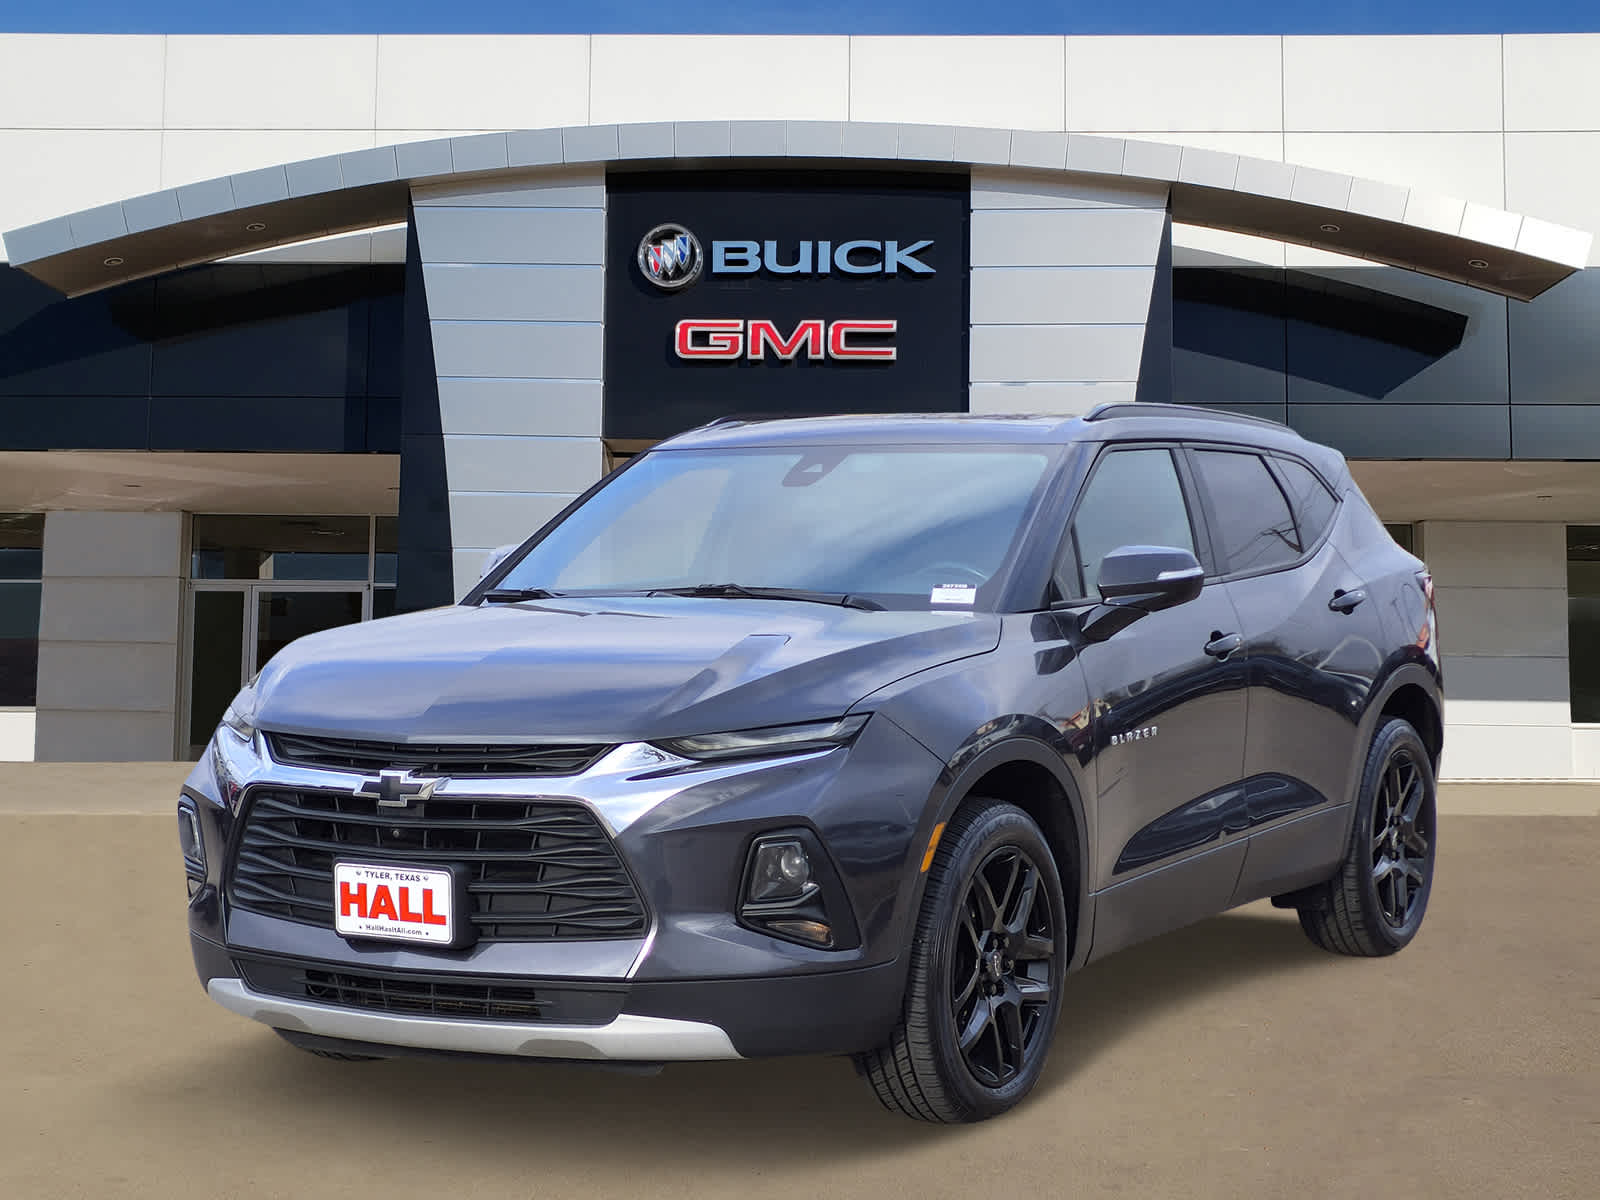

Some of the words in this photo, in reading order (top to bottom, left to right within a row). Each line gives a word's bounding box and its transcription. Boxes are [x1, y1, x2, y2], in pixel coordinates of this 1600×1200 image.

[712, 240, 936, 273] BUICK
[675, 319, 897, 360] GMC
[1111, 726, 1157, 745] BLAZER
[365, 870, 392, 880] TYLER,
[395, 873, 420, 882] TEXAS
[340, 881, 446, 925] HALL
[366, 924, 422, 935] HallHasItAll.com
